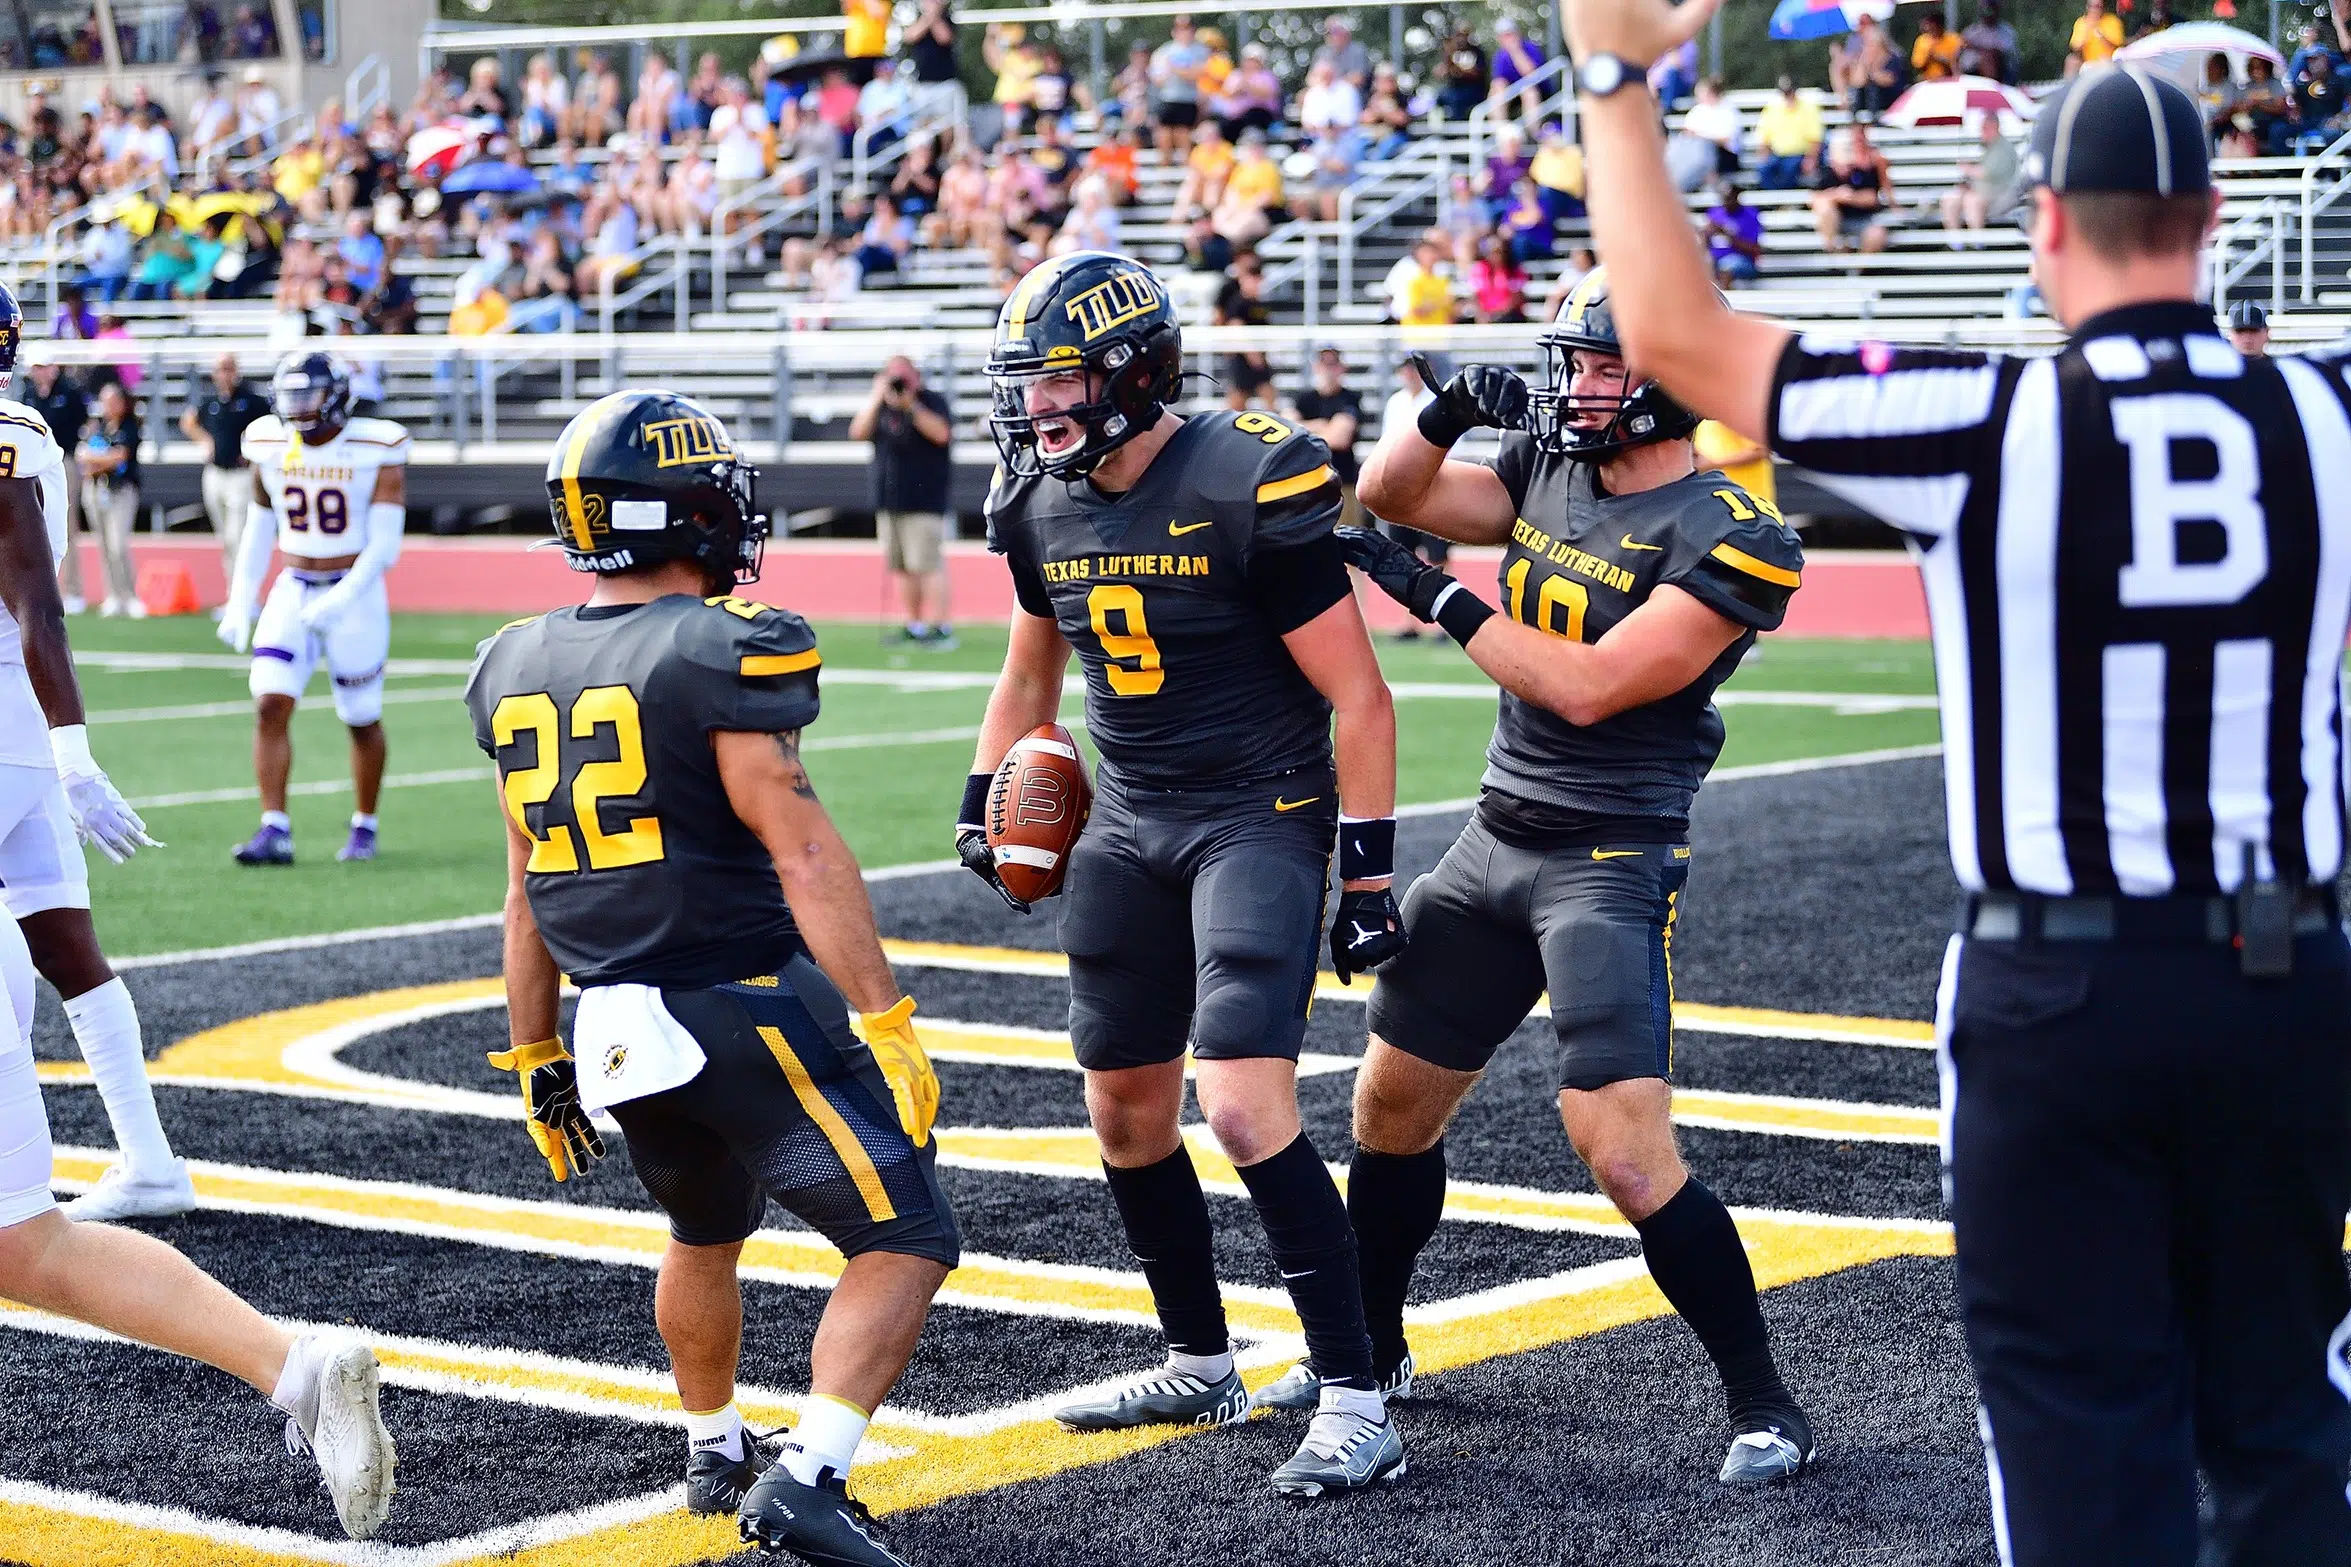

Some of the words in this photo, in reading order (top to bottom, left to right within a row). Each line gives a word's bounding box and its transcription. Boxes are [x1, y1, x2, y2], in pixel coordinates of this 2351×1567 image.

[1065, 271, 1160, 342] TLU
[1235, 412, 1291, 444] 9
[285, 488, 347, 534] 28
[555, 493, 610, 539] 22
[2110, 393, 2269, 607] B
[1043, 558, 1090, 582] TEXAS
[1098, 555, 1209, 576] LUTHERAN
[1511, 517, 1551, 554] TEXAS
[1546, 541, 1636, 593] LUTHERAN
[1086, 584, 1165, 696] 9
[491, 684, 665, 874] 22
[693, 1434, 727, 1448] PUMA
[771, 1496, 796, 1521] VAPOR
